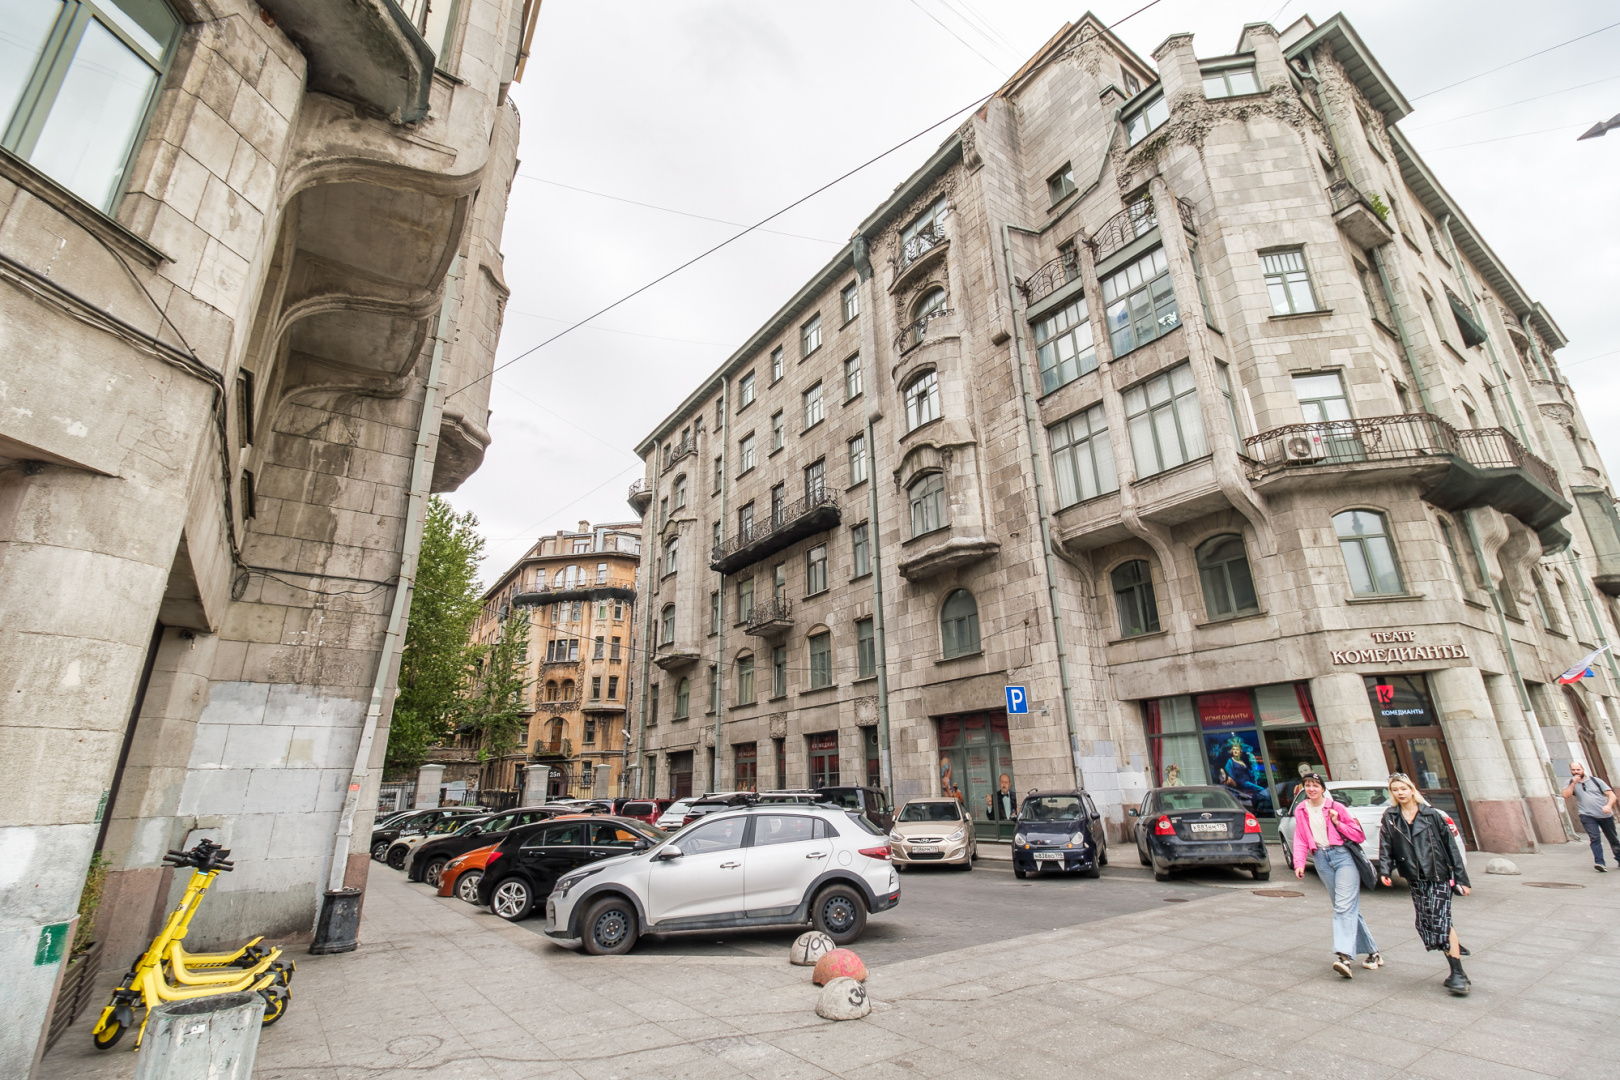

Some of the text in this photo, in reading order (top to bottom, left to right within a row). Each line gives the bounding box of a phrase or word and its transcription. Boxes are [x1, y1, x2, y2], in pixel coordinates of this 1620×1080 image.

[1371, 631, 1417, 644] ТЕАТР
[1330, 644, 1470, 665] КОМЕДИАНТЫ
[1011, 689, 1023, 711] P
[1204, 712, 1249, 721] КОМЕДИАНТЫ
[1381, 708, 1424, 717] КОМЕДИАНТЫ
